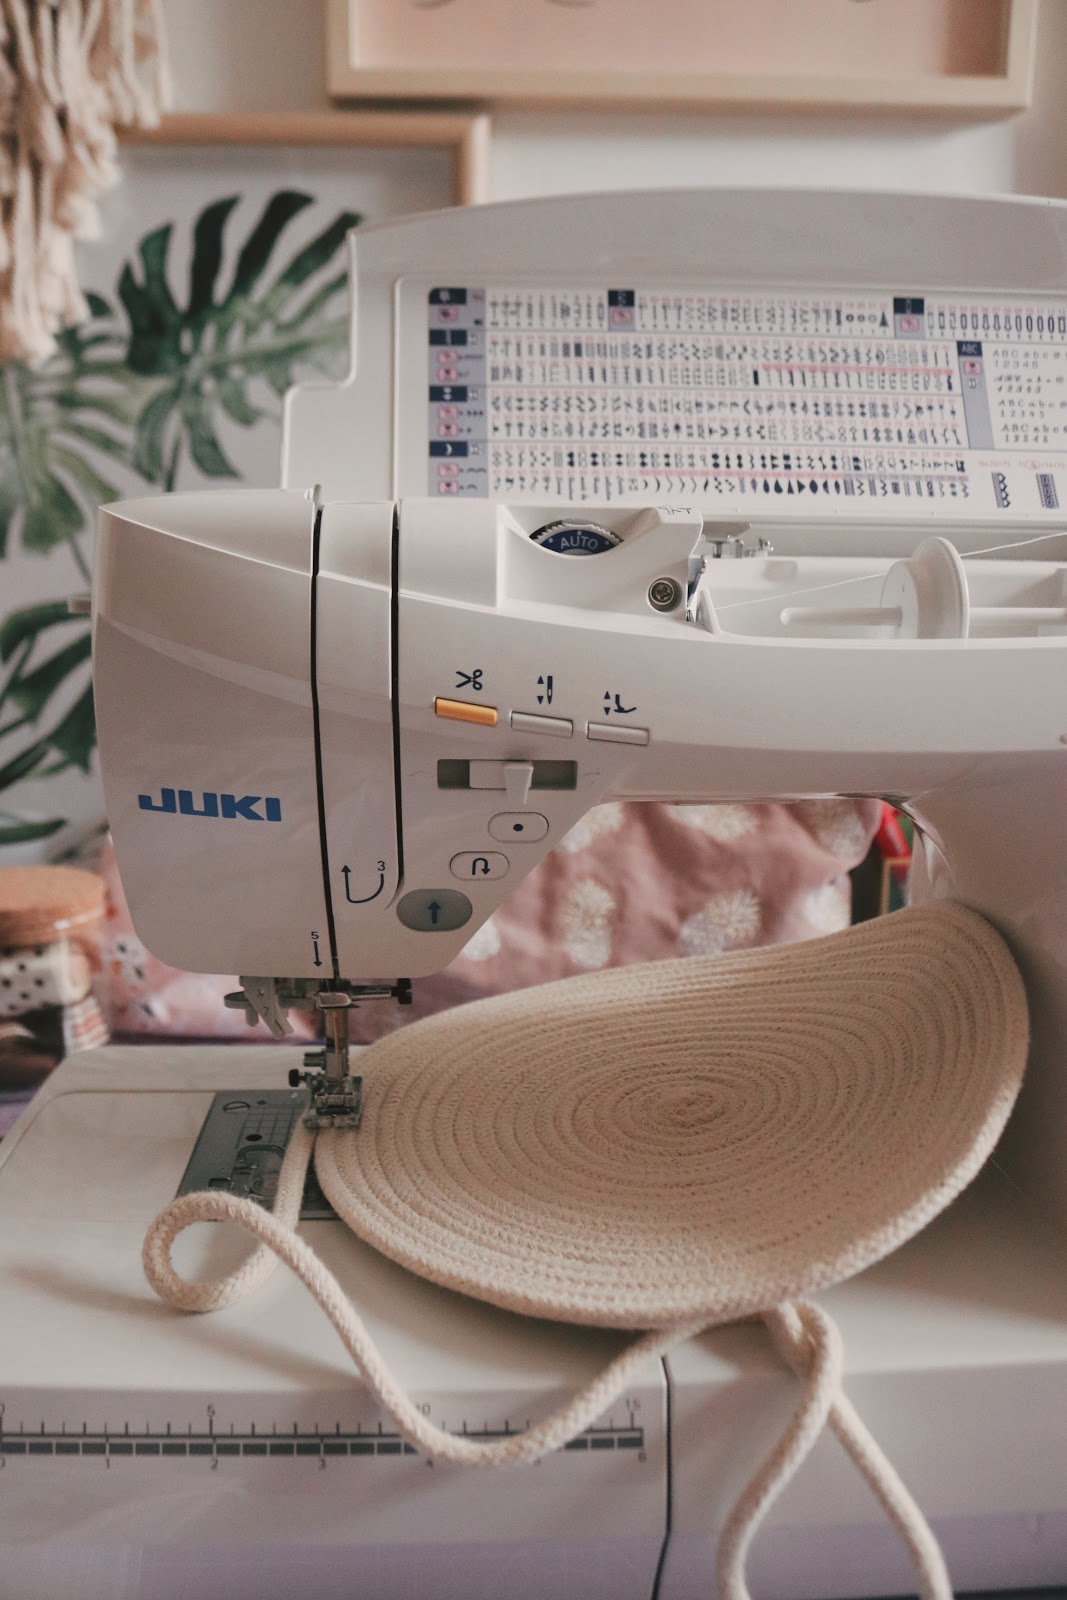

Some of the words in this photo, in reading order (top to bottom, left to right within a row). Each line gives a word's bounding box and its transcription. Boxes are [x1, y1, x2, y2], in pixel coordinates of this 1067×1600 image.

[559, 533, 599, 551] AUTO
[138, 787, 282, 822] JUKI
[377, 860, 386, 871] 3
[311, 931, 320, 940] 5
[207, 1403, 216, 1417] 5
